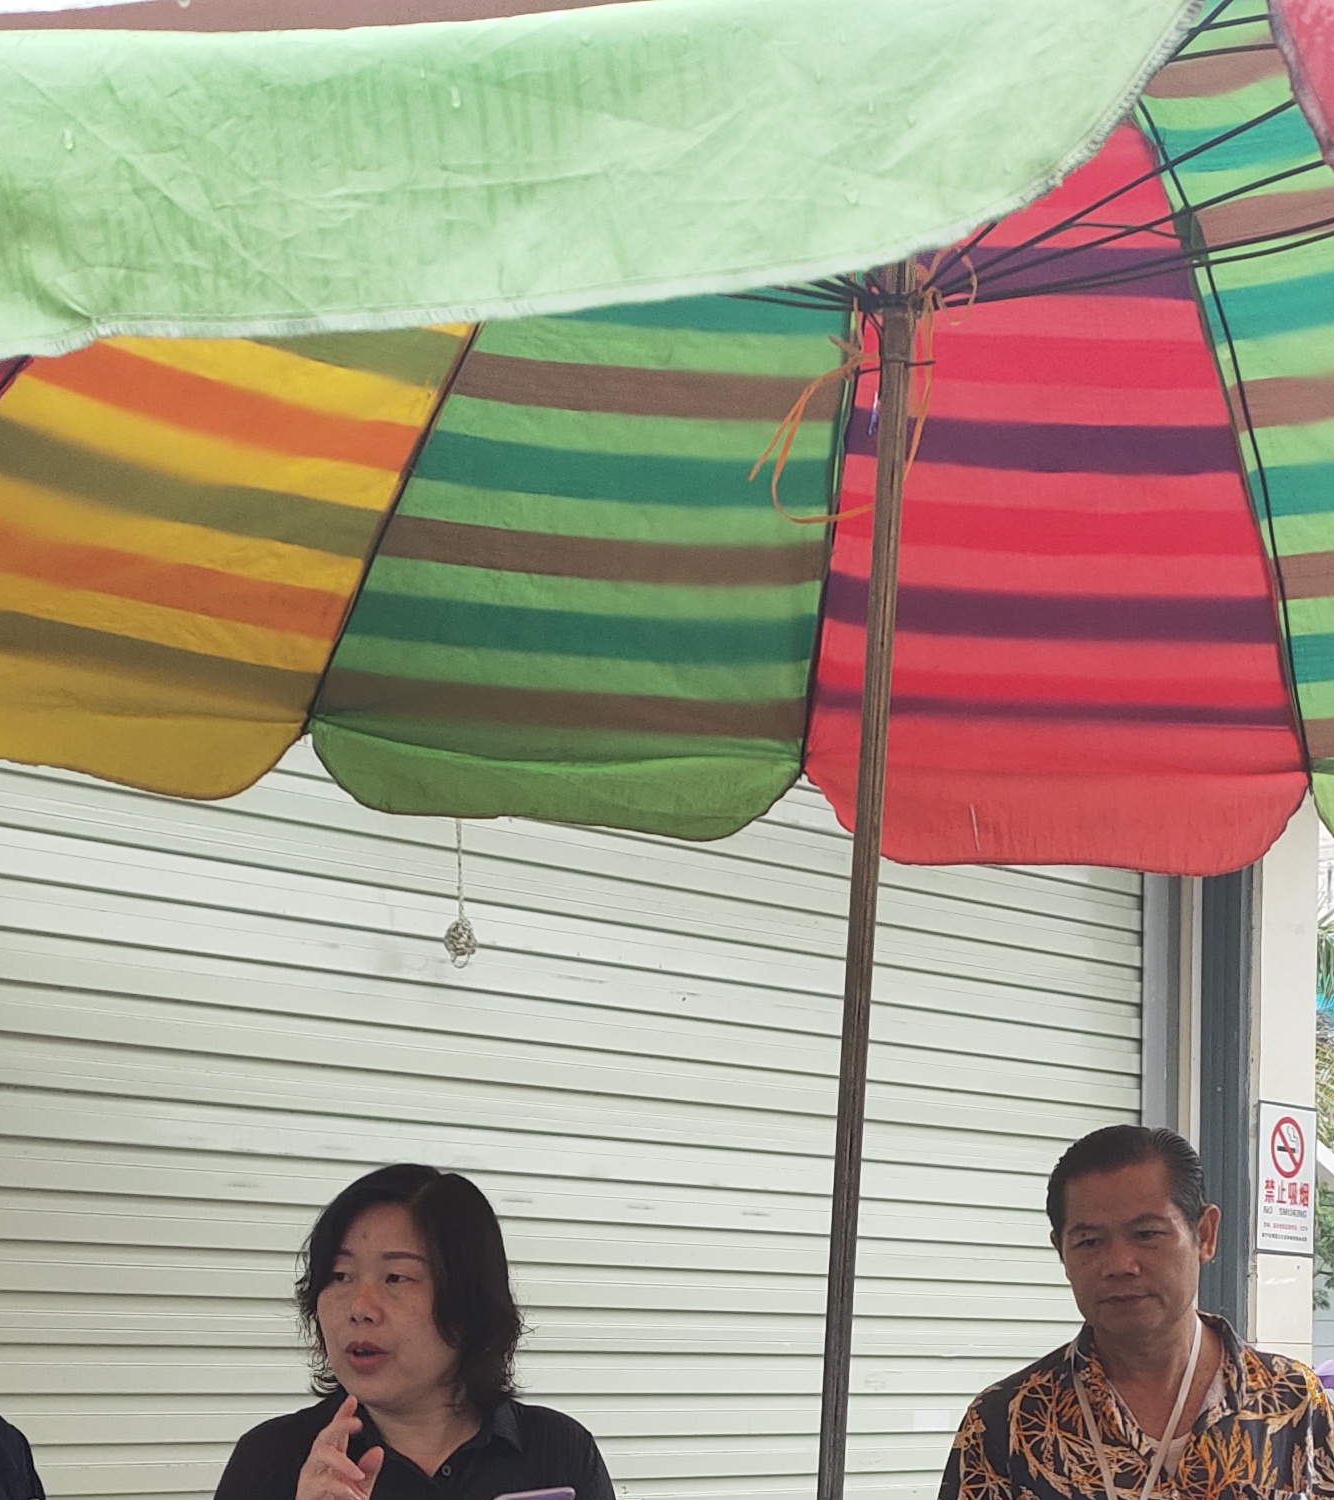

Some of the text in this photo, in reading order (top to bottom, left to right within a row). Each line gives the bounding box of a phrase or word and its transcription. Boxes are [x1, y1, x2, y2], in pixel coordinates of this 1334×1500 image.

[1264, 1178, 1310, 1208] 禁止吸烟
[1263, 1206, 1308, 1218] NO SMOKING
